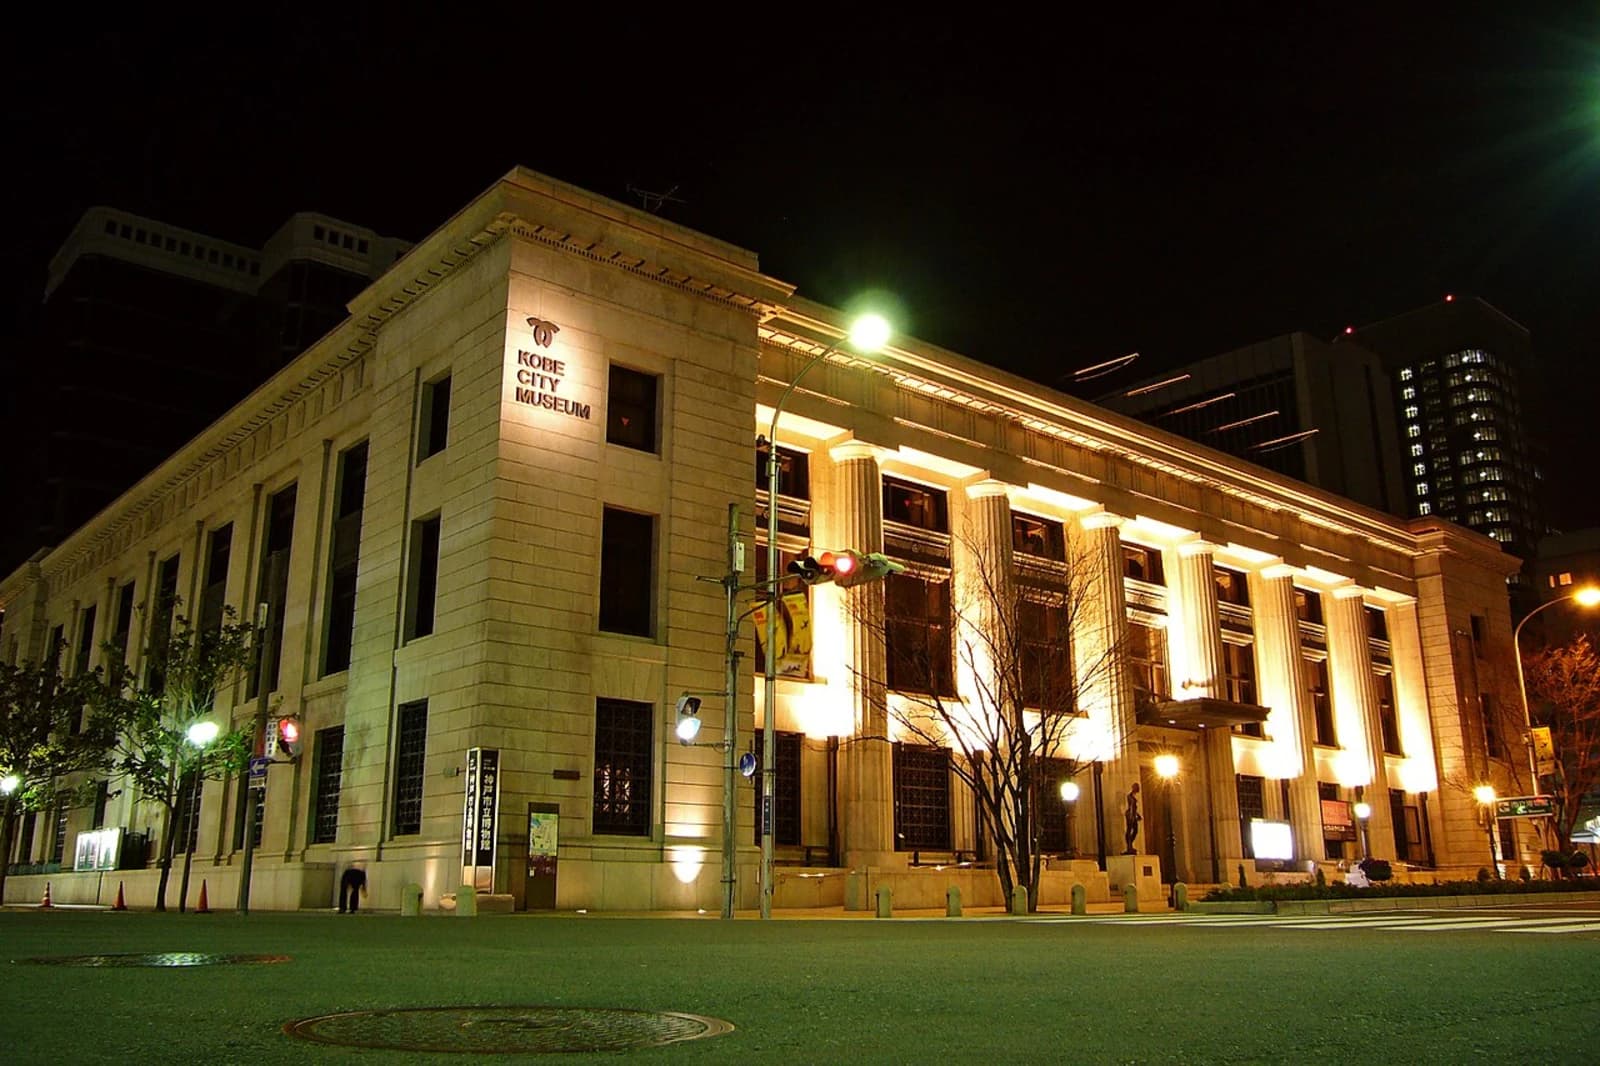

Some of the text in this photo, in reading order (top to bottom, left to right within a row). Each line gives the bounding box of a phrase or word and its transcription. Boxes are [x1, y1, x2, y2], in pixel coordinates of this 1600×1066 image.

[518, 349, 566, 376] KOBE
[517, 369, 560, 392] CITY
[515, 386, 591, 420] MUSEUM
